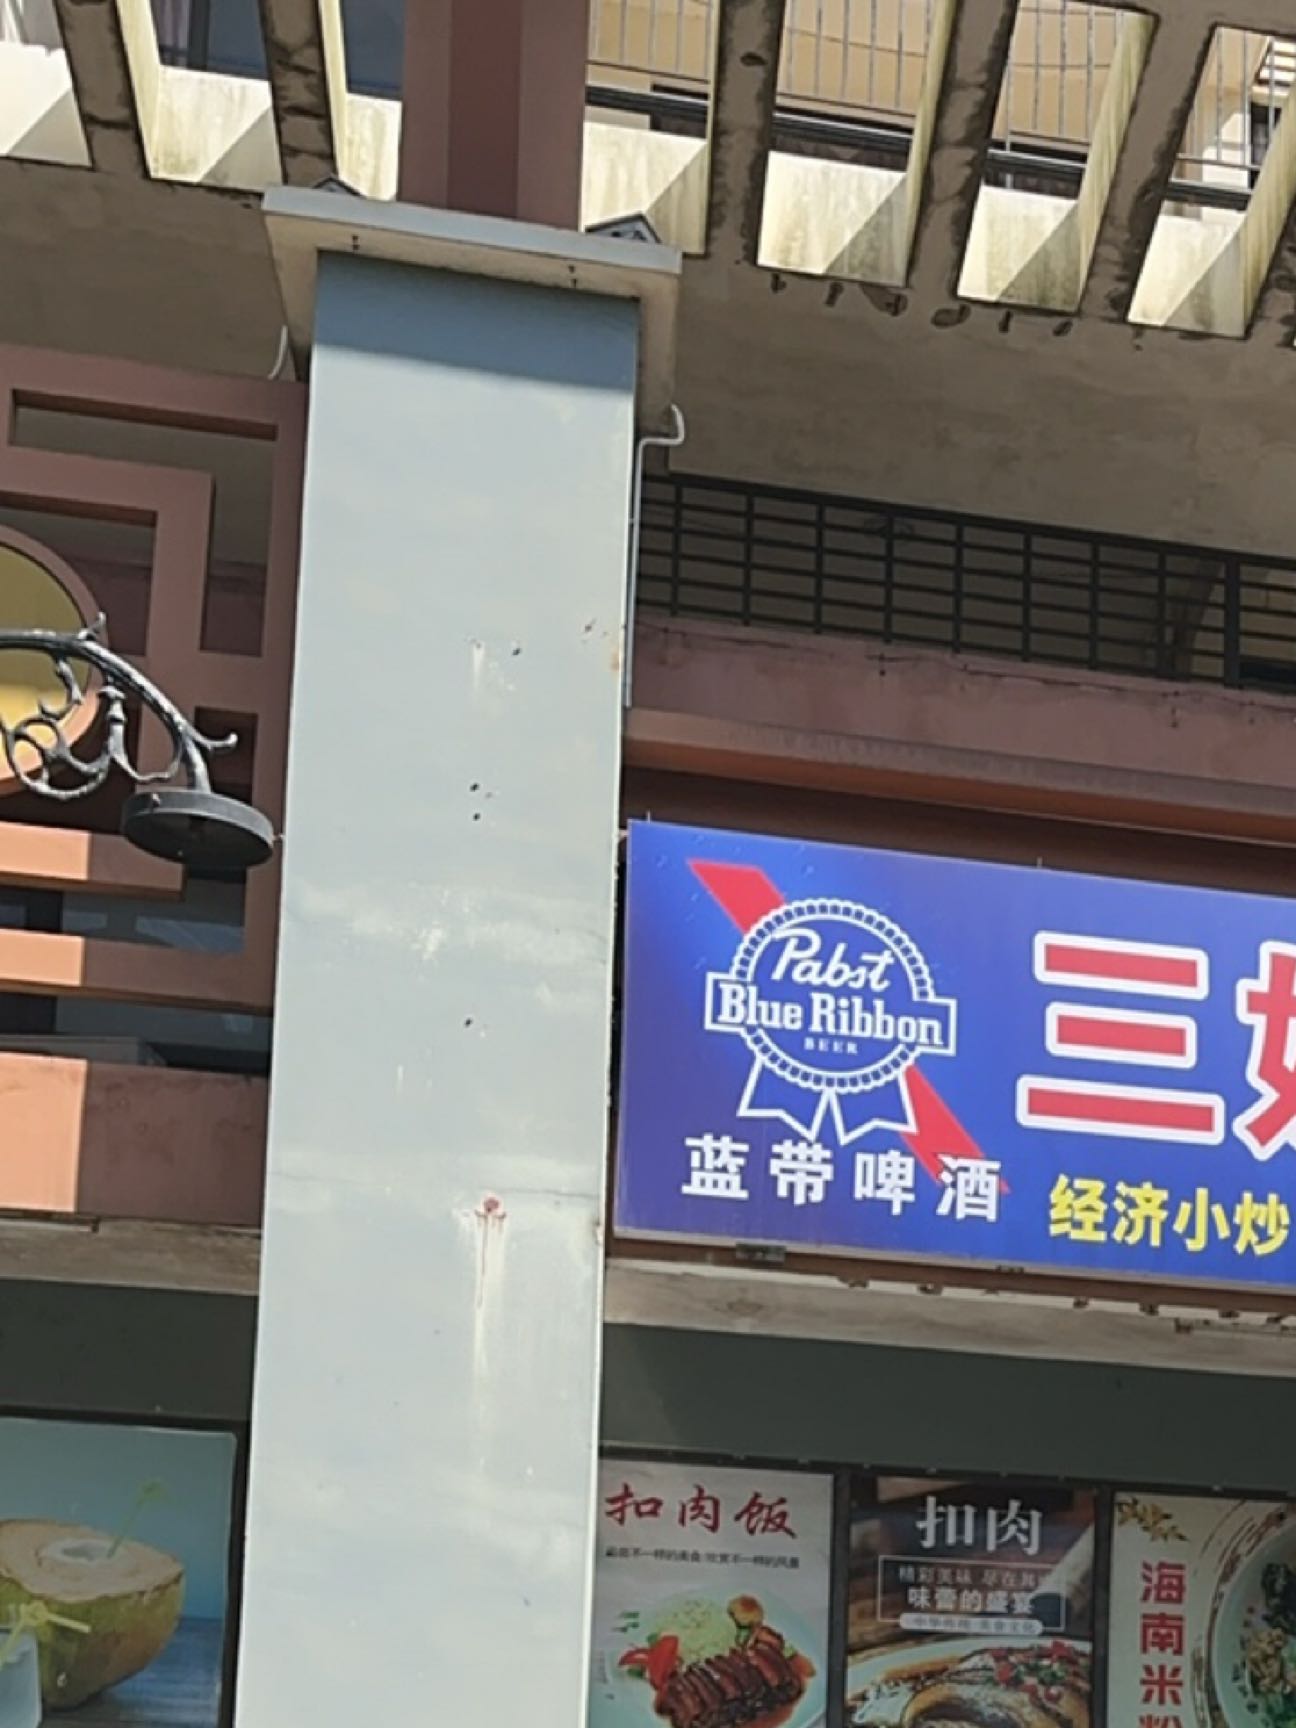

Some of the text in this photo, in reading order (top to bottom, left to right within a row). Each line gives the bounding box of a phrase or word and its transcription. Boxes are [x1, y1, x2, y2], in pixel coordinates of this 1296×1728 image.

[771, 928, 895, 992] Pabst
[718, 981, 943, 1046] Blue Ribbon
[682, 1134, 1001, 1223] 蓝带啤酒
[1050, 1173, 1290, 1257] 经济小炒
[604, 1483, 798, 1539] 扣肉饭
[916, 1496, 1043, 1555] 扣肉
